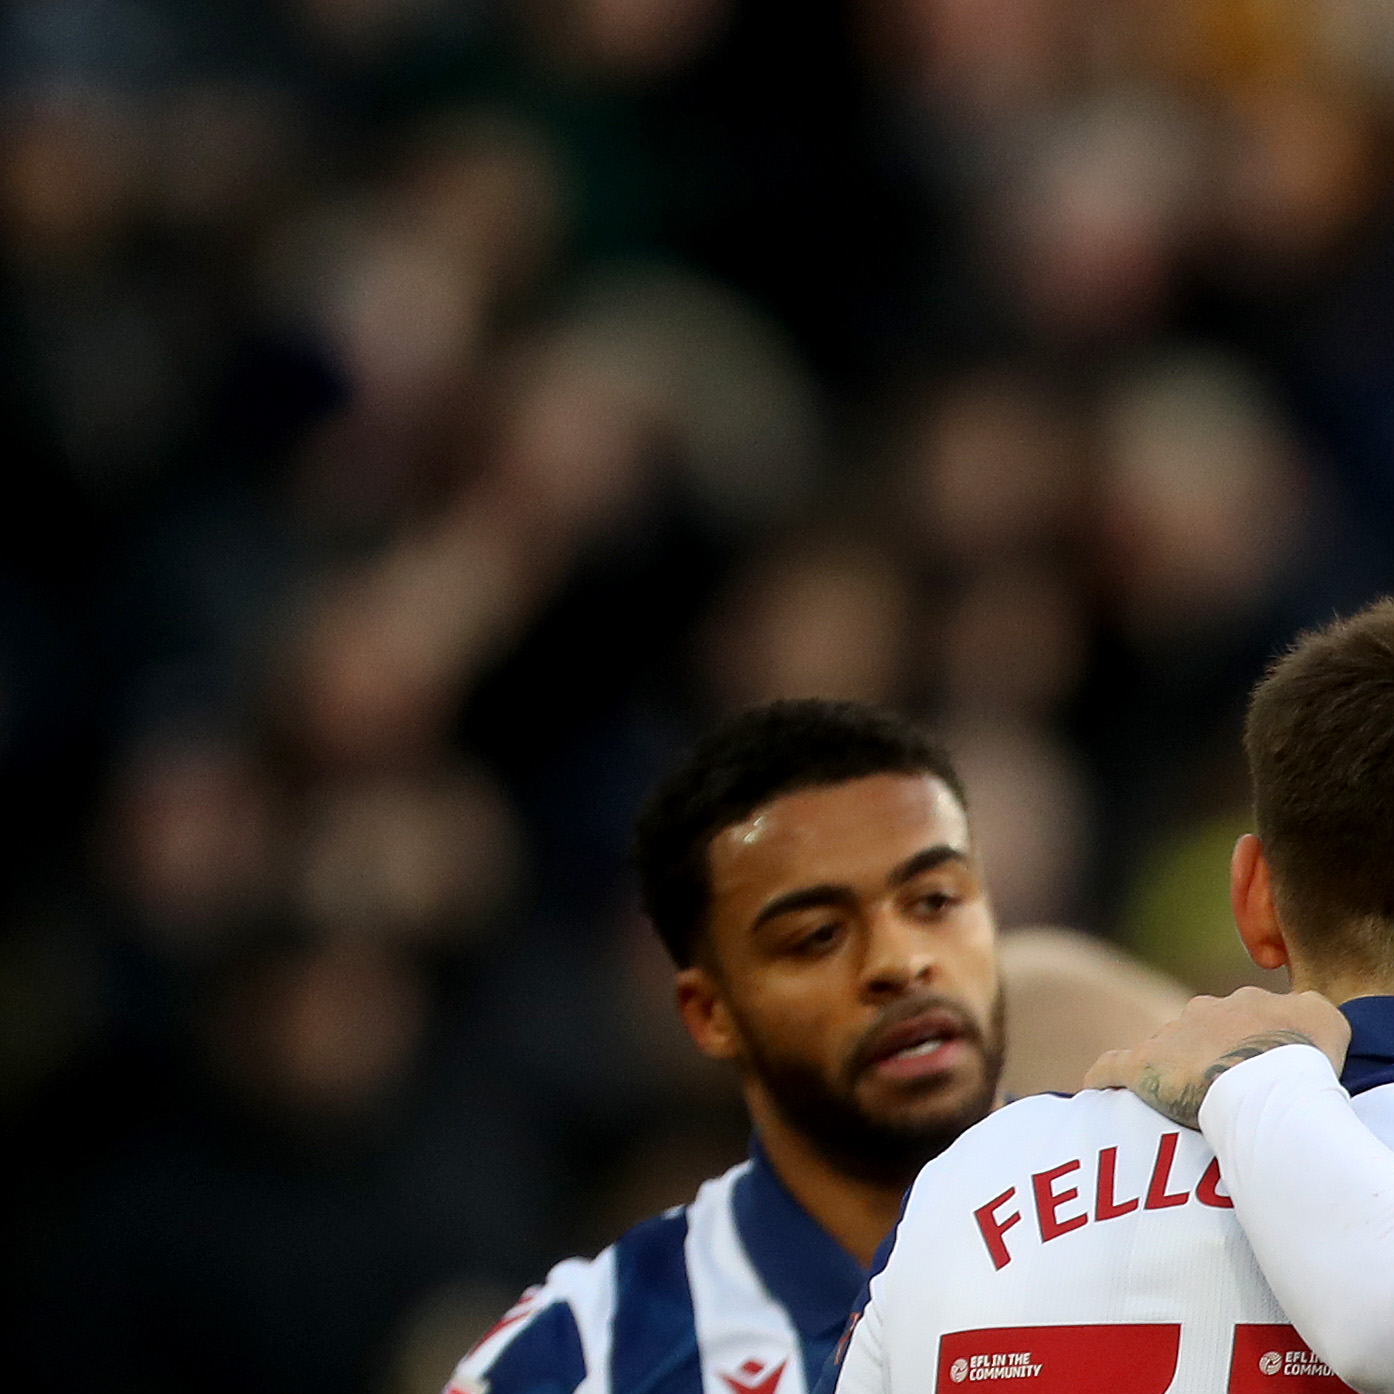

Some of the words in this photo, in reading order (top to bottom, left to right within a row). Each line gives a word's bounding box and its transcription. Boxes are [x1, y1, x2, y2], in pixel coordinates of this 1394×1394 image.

[969, 1355, 990, 1368] EFL
[991, 1353, 1006, 1367] IN
[1008, 1352, 1032, 1365] THE
[1285, 1351, 1306, 1363] EFL
[969, 1364, 1043, 1381] COMMUNITY
